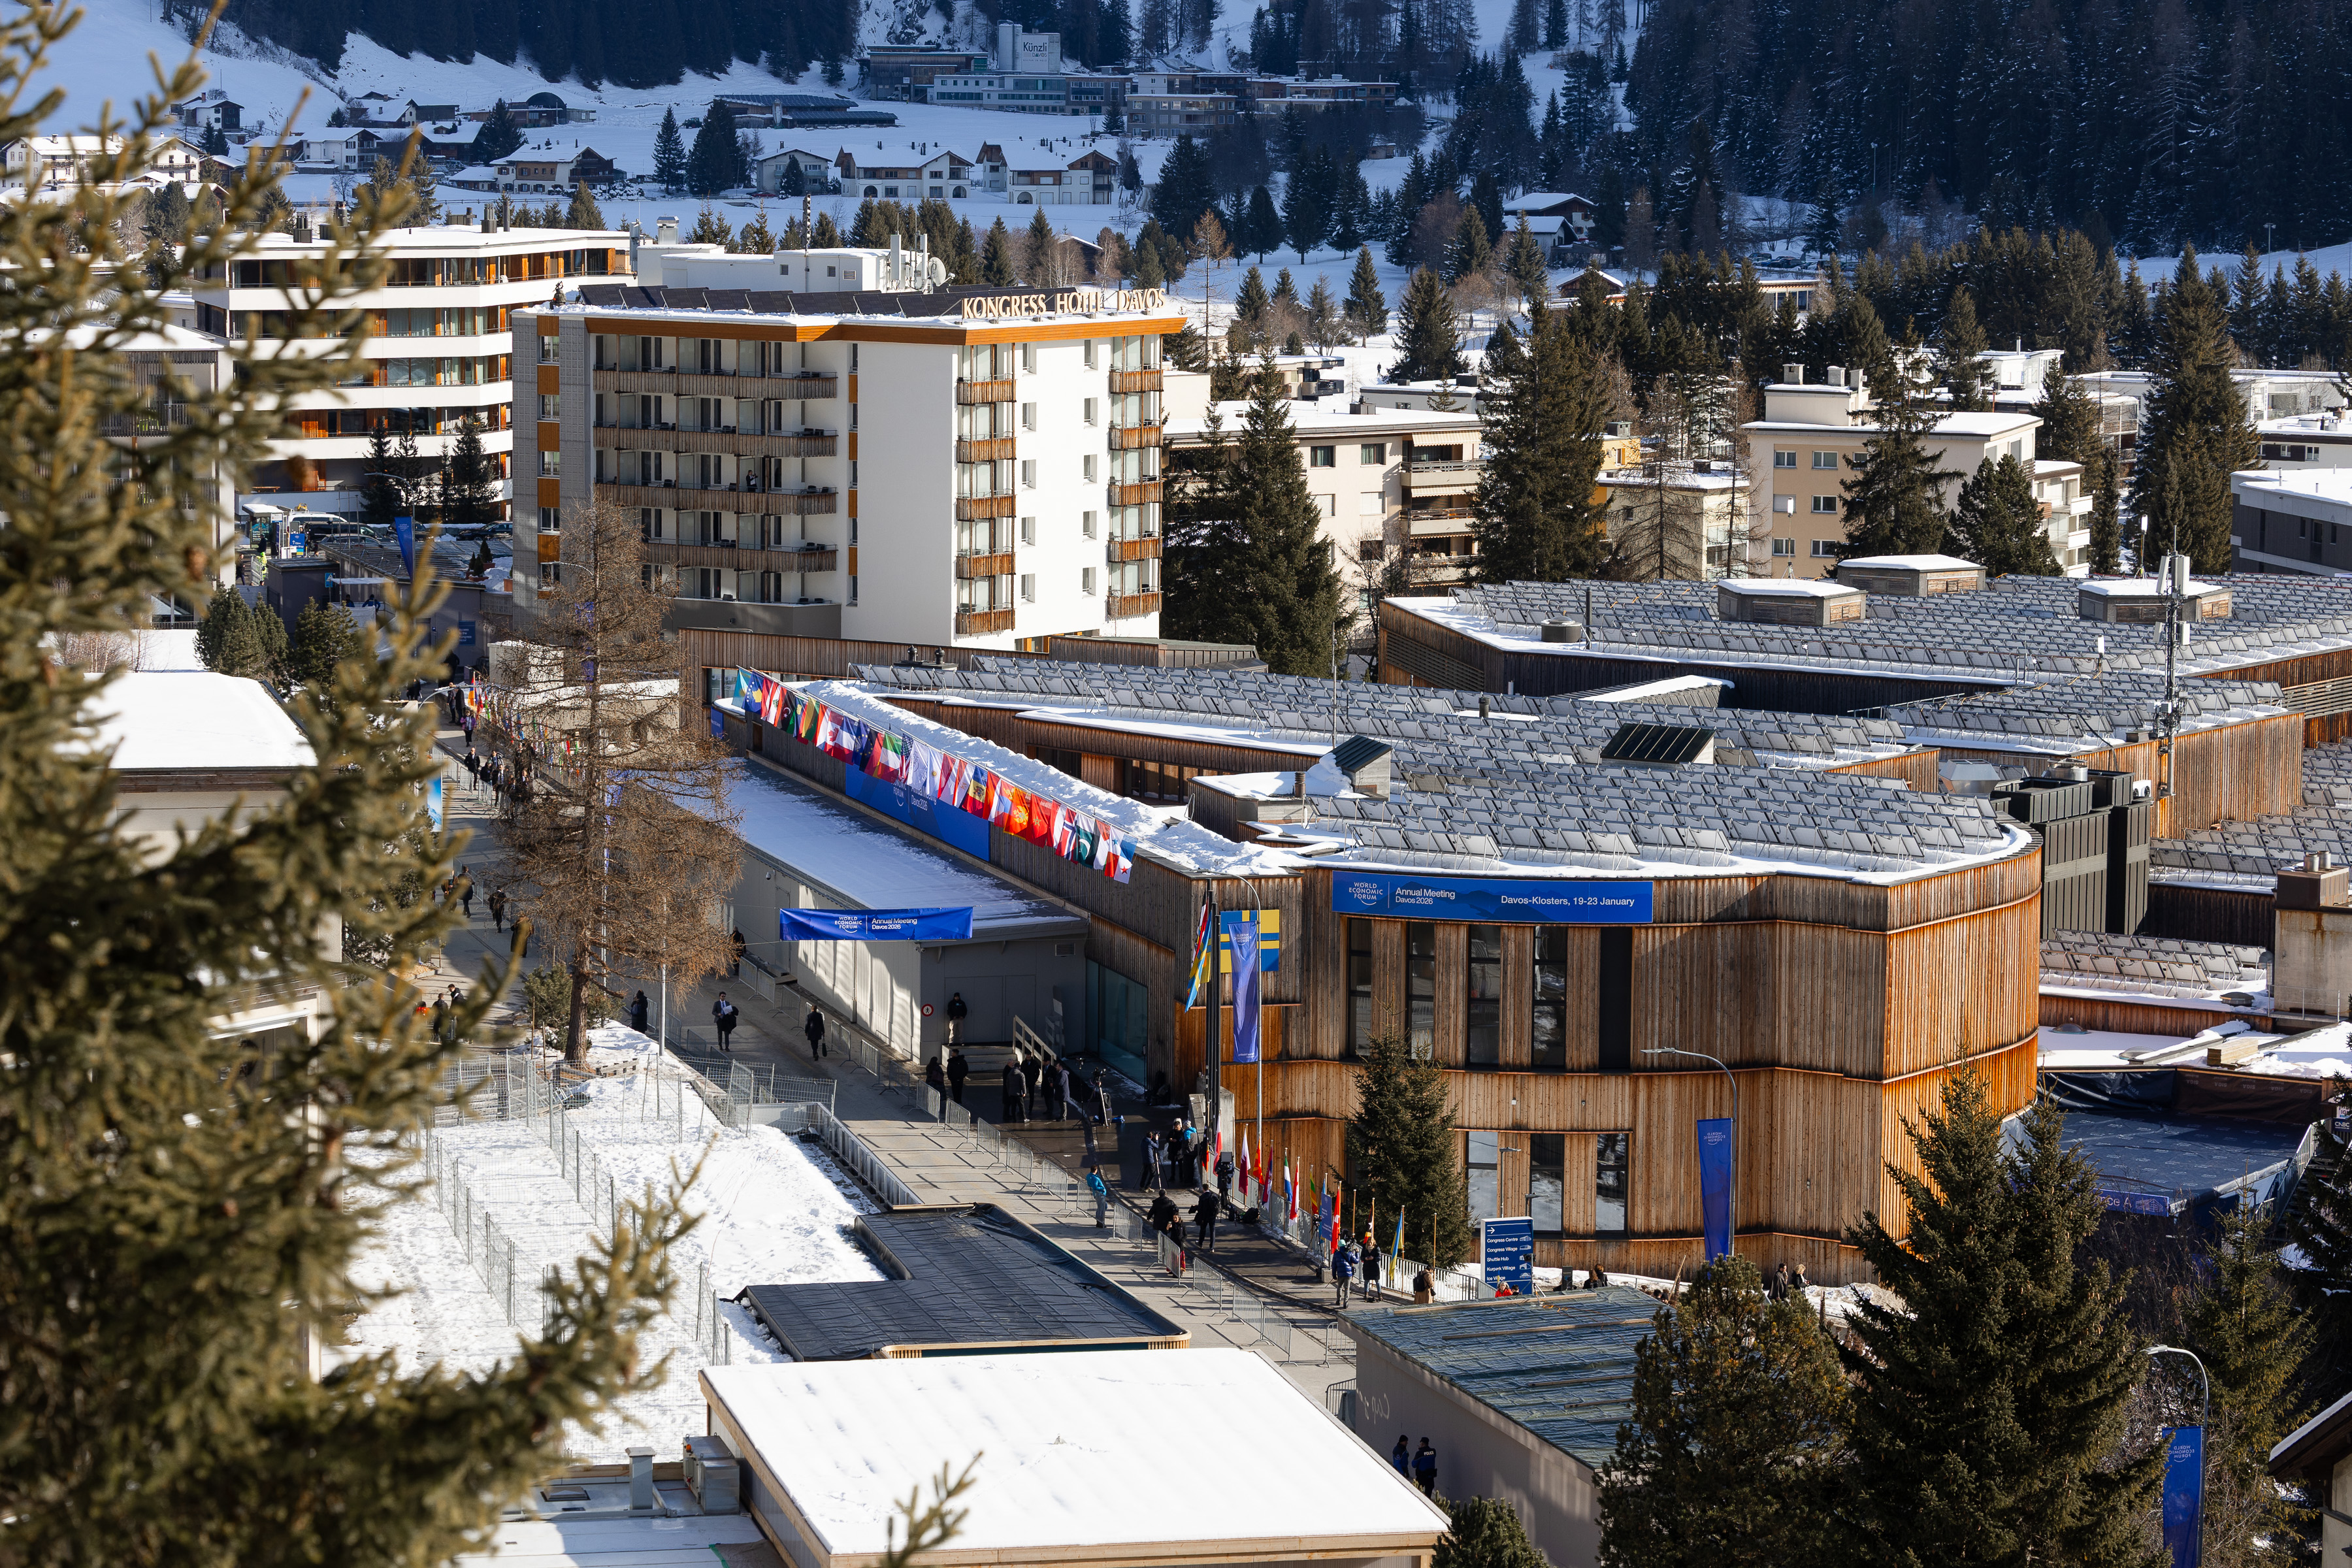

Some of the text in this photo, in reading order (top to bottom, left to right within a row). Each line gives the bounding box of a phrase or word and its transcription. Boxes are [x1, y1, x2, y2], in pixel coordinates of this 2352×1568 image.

[1023, 42, 1047, 52] Künzli
[962, 288, 1166, 319] KONGRESS HOTEL DAVOS
[1396, 887, 1455, 900] Annual Meeting
[1501, 896, 1635, 907] Davos-Klosters, 19-23 January
